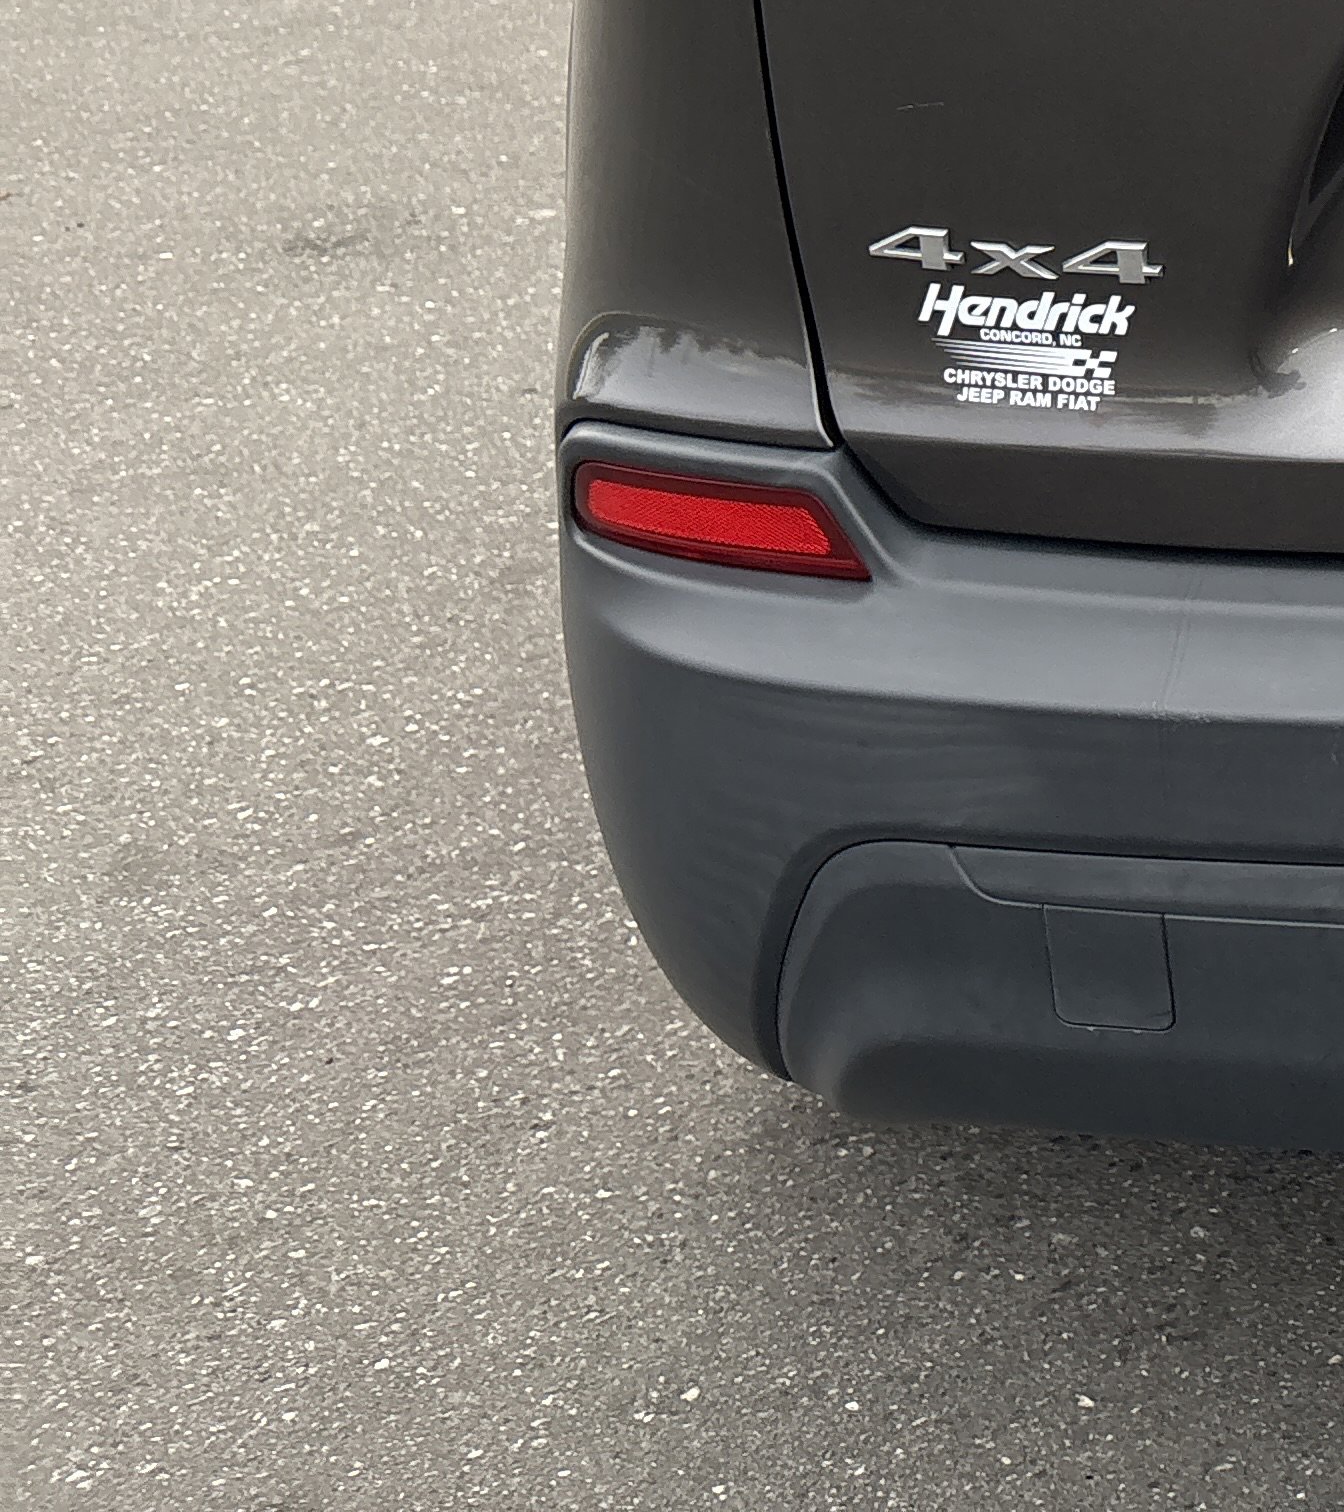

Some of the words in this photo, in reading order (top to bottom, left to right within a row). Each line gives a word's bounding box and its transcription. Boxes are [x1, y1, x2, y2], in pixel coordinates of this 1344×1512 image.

[917, 282, 1136, 336] Hendrick
[979, 328, 1057, 348] CONCORD,
[1059, 333, 1082, 348] NC
[943, 368, 1044, 391] CHRYSLER
[1048, 376, 1116, 396] DODGE
[956, 386, 1004, 405] JEEP
[1009, 390, 1052, 408] RAM
[1056, 393, 1101, 412] FIAT
